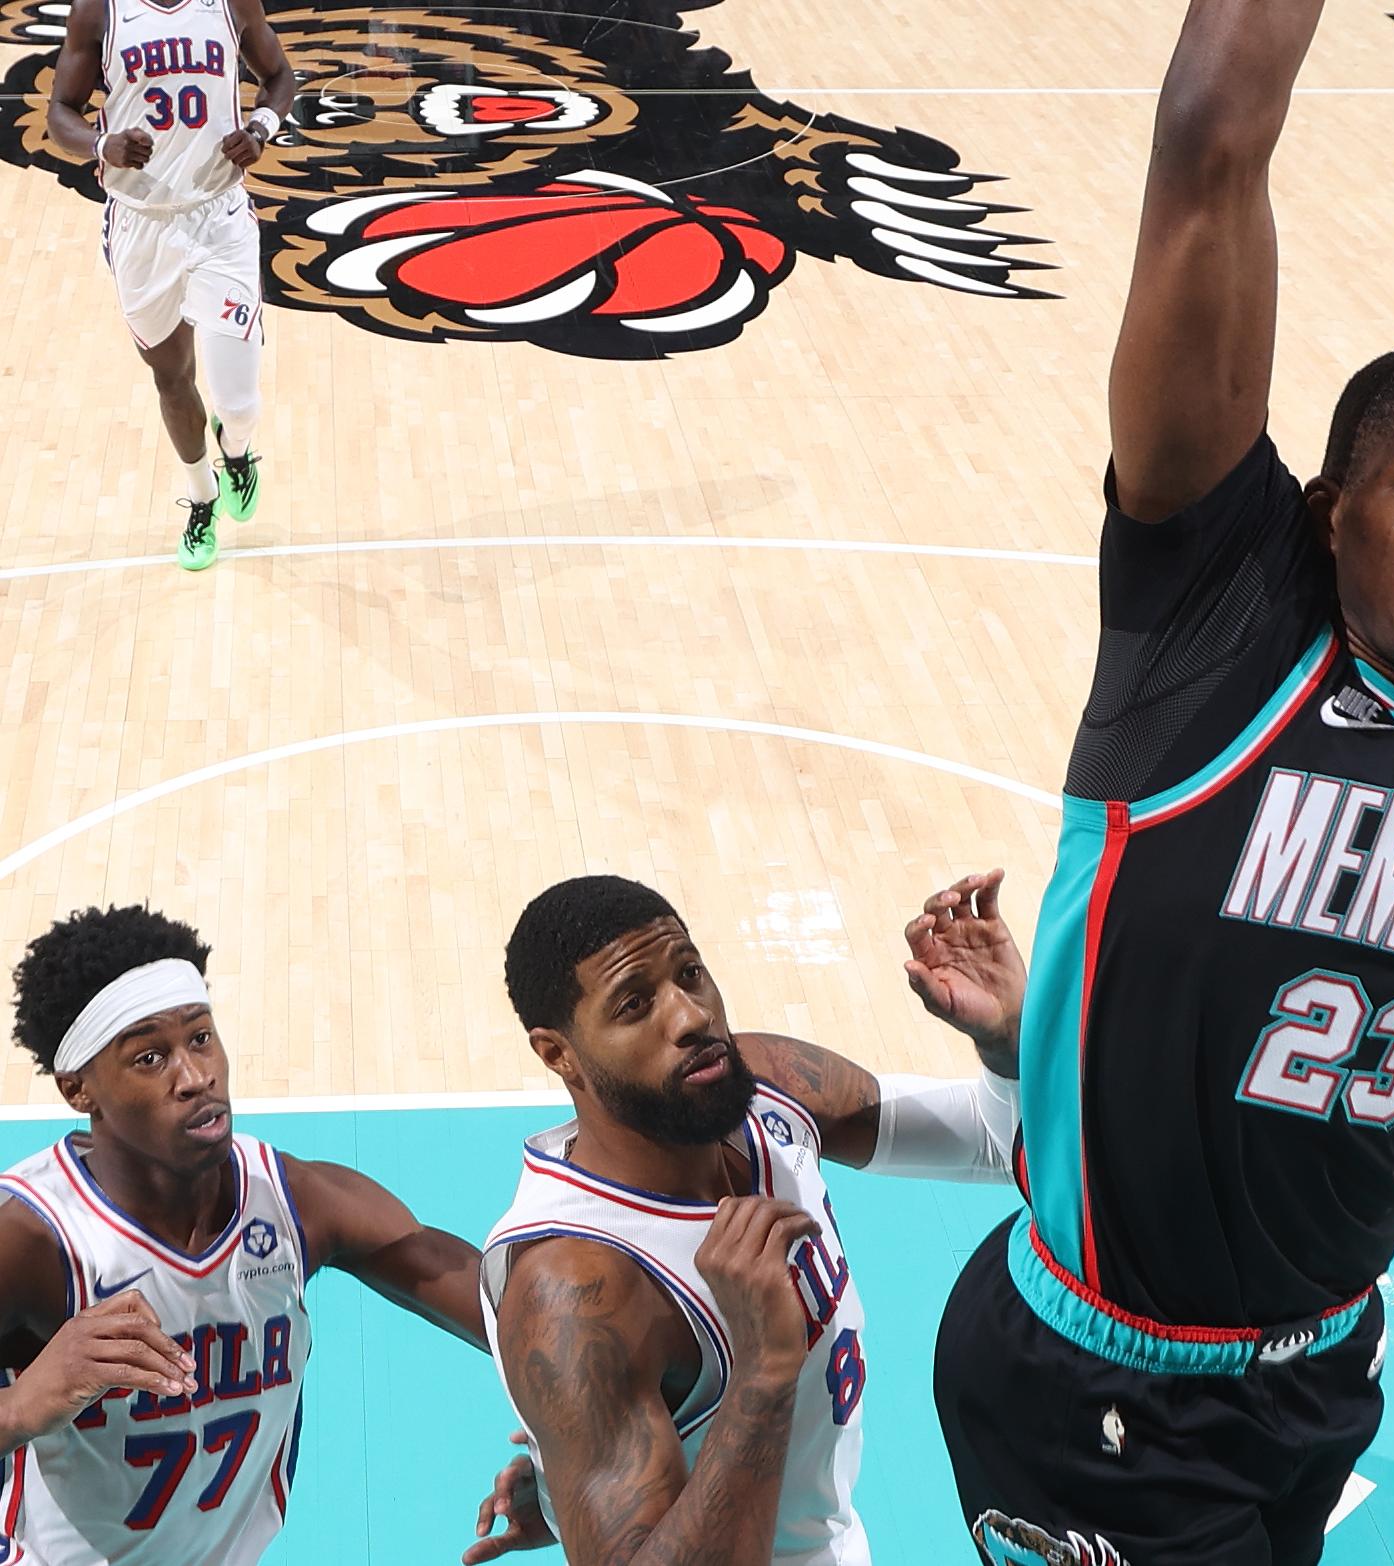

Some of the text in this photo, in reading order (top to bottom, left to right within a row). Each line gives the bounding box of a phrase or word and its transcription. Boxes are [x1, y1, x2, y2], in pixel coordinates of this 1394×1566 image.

[120, 37, 225, 84] PHILA
[143, 84, 208, 131] 30
[220, 297, 250, 326] 76
[1334, 685, 1383, 722] NIKE
[124, 1409, 261, 1530] 77
